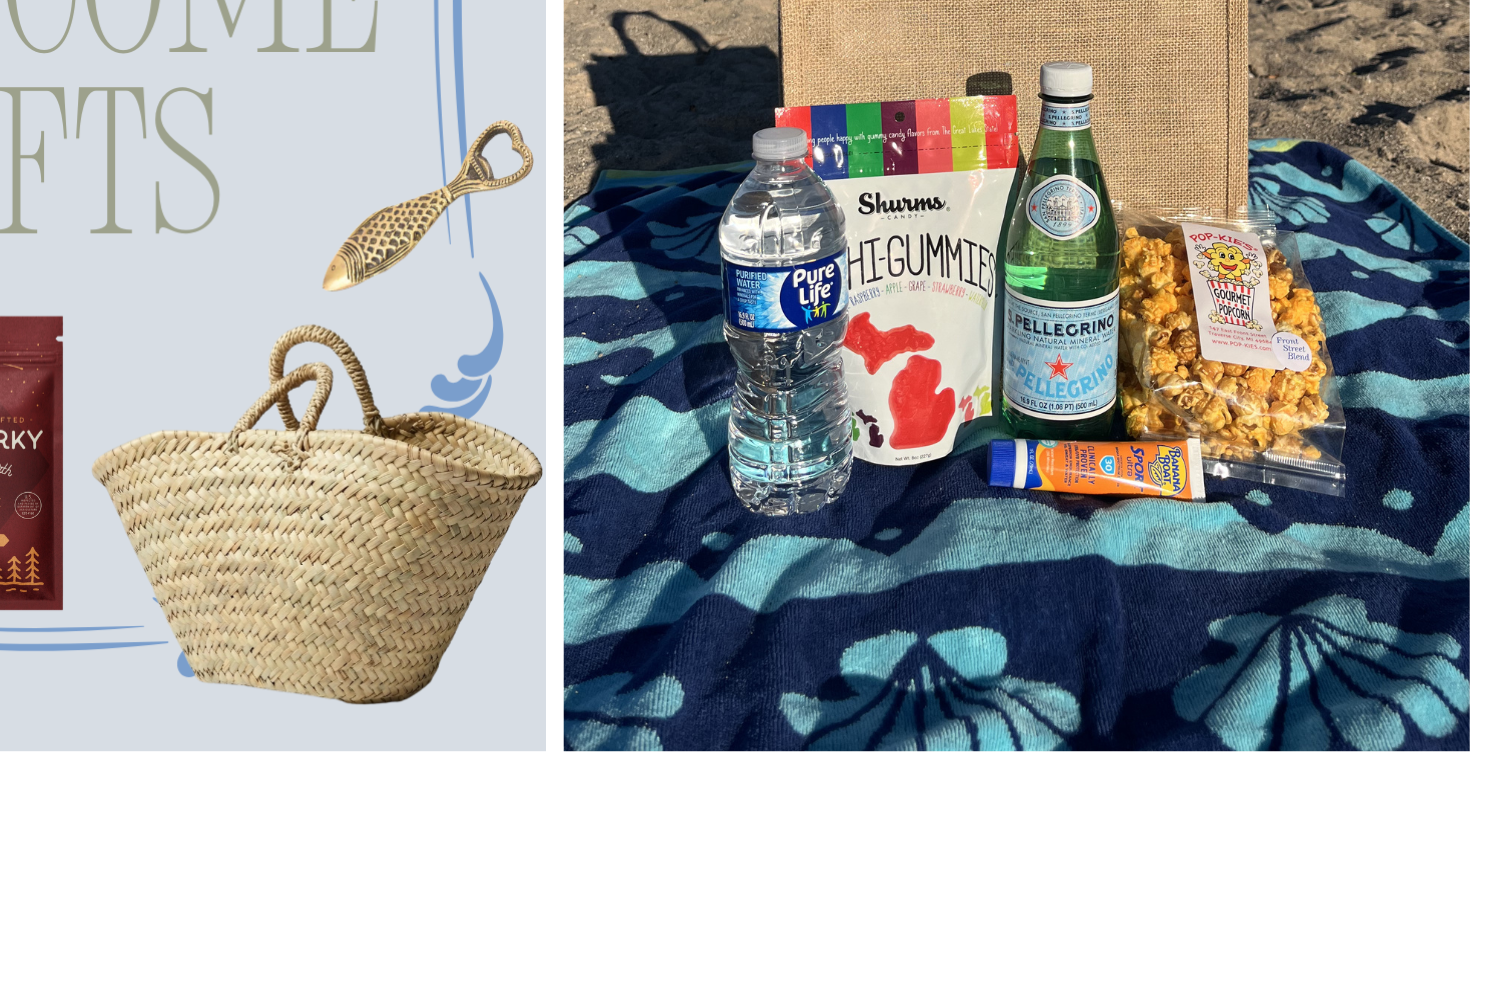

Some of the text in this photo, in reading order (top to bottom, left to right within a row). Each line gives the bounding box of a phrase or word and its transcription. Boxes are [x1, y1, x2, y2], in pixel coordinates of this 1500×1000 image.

[817, 128, 925, 146] people happy gummy candy flavors
[858, 191, 946, 215] Shurms
[886, 213, 919, 221] CANDY
[736, 269, 767, 281] PURIFIED
[736, 278, 760, 289] WATER
[793, 263, 834, 288] Pure
[799, 282, 831, 306] Life
[885, 280, 966, 298] APPLE GRAPE STRAWBERRY
[1213, 288, 1251, 306] GOURMET
[1219, 304, 1250, 320] POPCORN
[1008, 309, 1115, 337] S.PELLEGRINO
[1033, 335, 1100, 345] NATURAL MINERAL
[1276, 336, 1299, 345] Front
[1288, 351, 1310, 361] Blend
[1016, 354, 1113, 399] PELLEGRINO
[1039, 401, 1047, 409] OZ
[1087, 445, 1095, 485] CLINICALLY
[1105, 459, 1113, 471] 30
[1157, 454, 1172, 485] BOAT
[1168, 445, 1181, 492] BANANA
